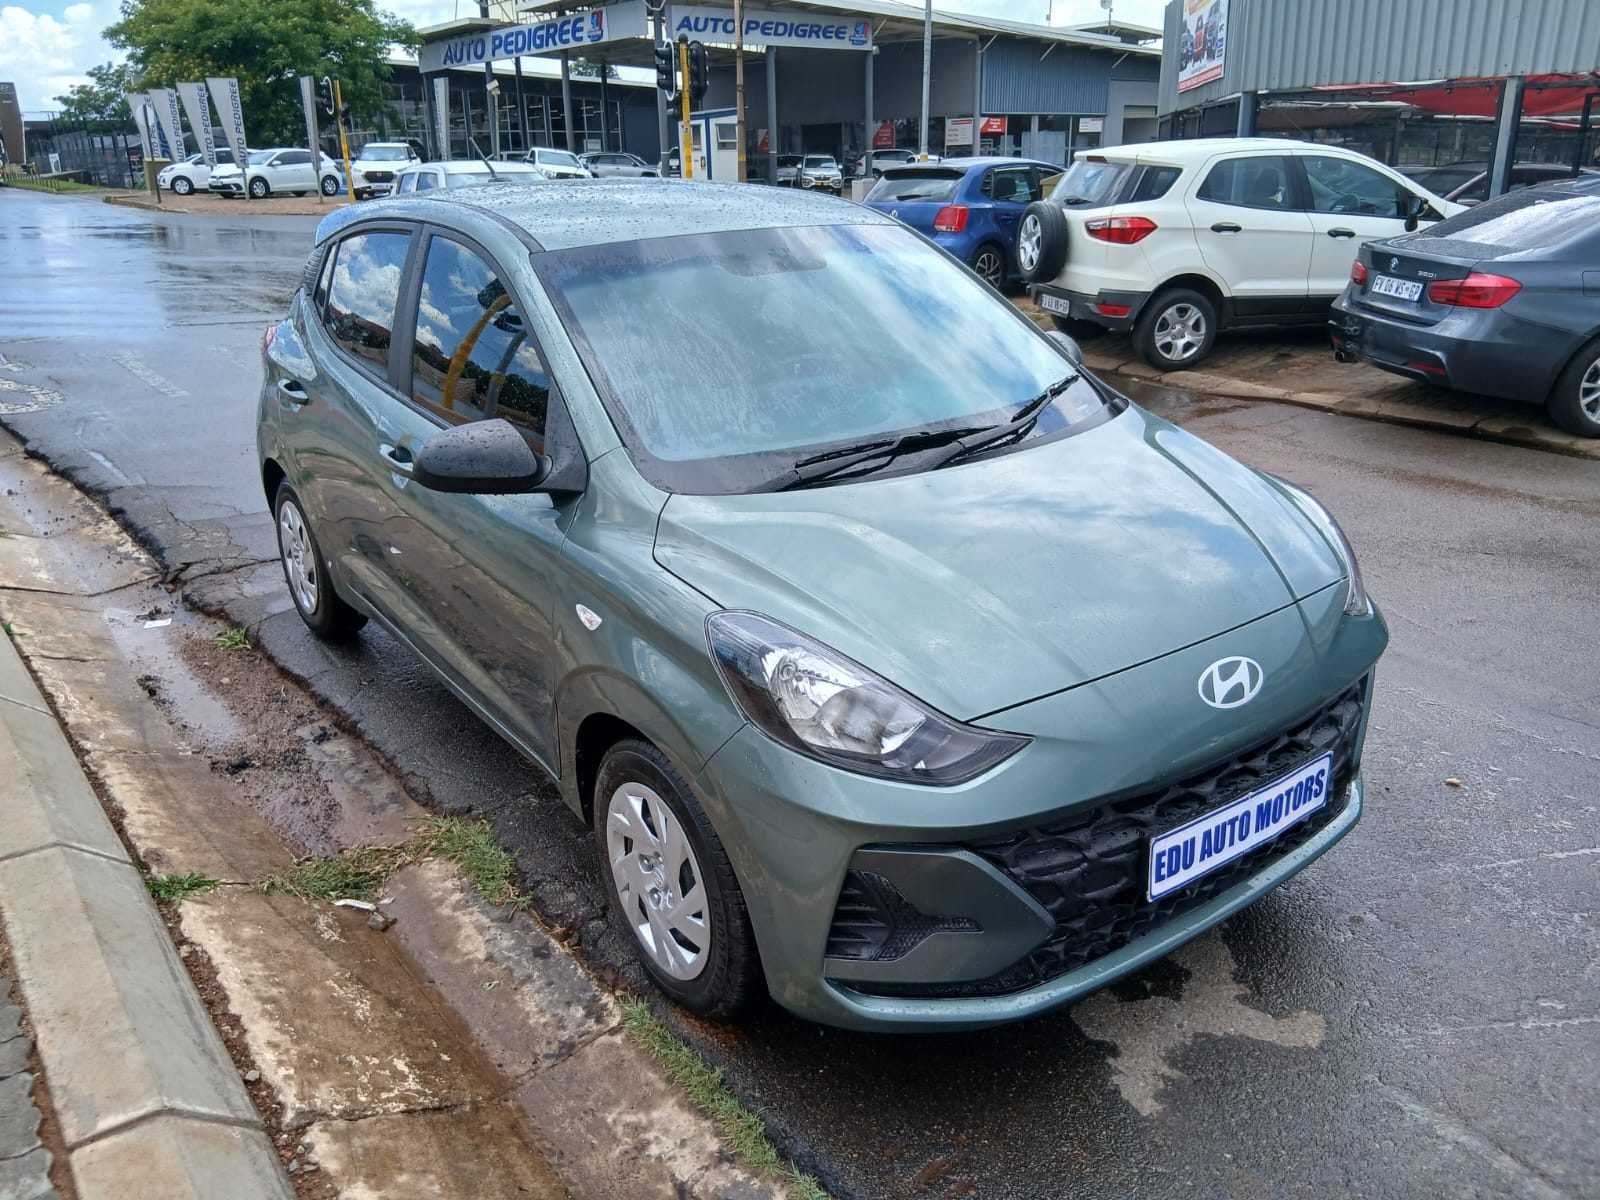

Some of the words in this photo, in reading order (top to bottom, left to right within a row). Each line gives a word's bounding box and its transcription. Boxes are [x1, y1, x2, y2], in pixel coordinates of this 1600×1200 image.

[442, 36, 486, 66] AUTO
[490, 16, 585, 57] PEDIGREE
[676, 15, 736, 33] AUTO
[744, 20, 847, 40] PEDIGREE
[168, 91, 182, 138] PEDIGREE
[196, 84, 212, 135] PEDIGREE
[228, 80, 243, 135] PEDIGREE
[204, 136, 215, 163] AUTO
[236, 137, 248, 166] AUTO
[1409, 284, 1421, 298] GP
[1154, 836, 1196, 883] EDU
[1199, 810, 1250, 862] AUTO
[1254, 768, 1326, 833] MOTORS
